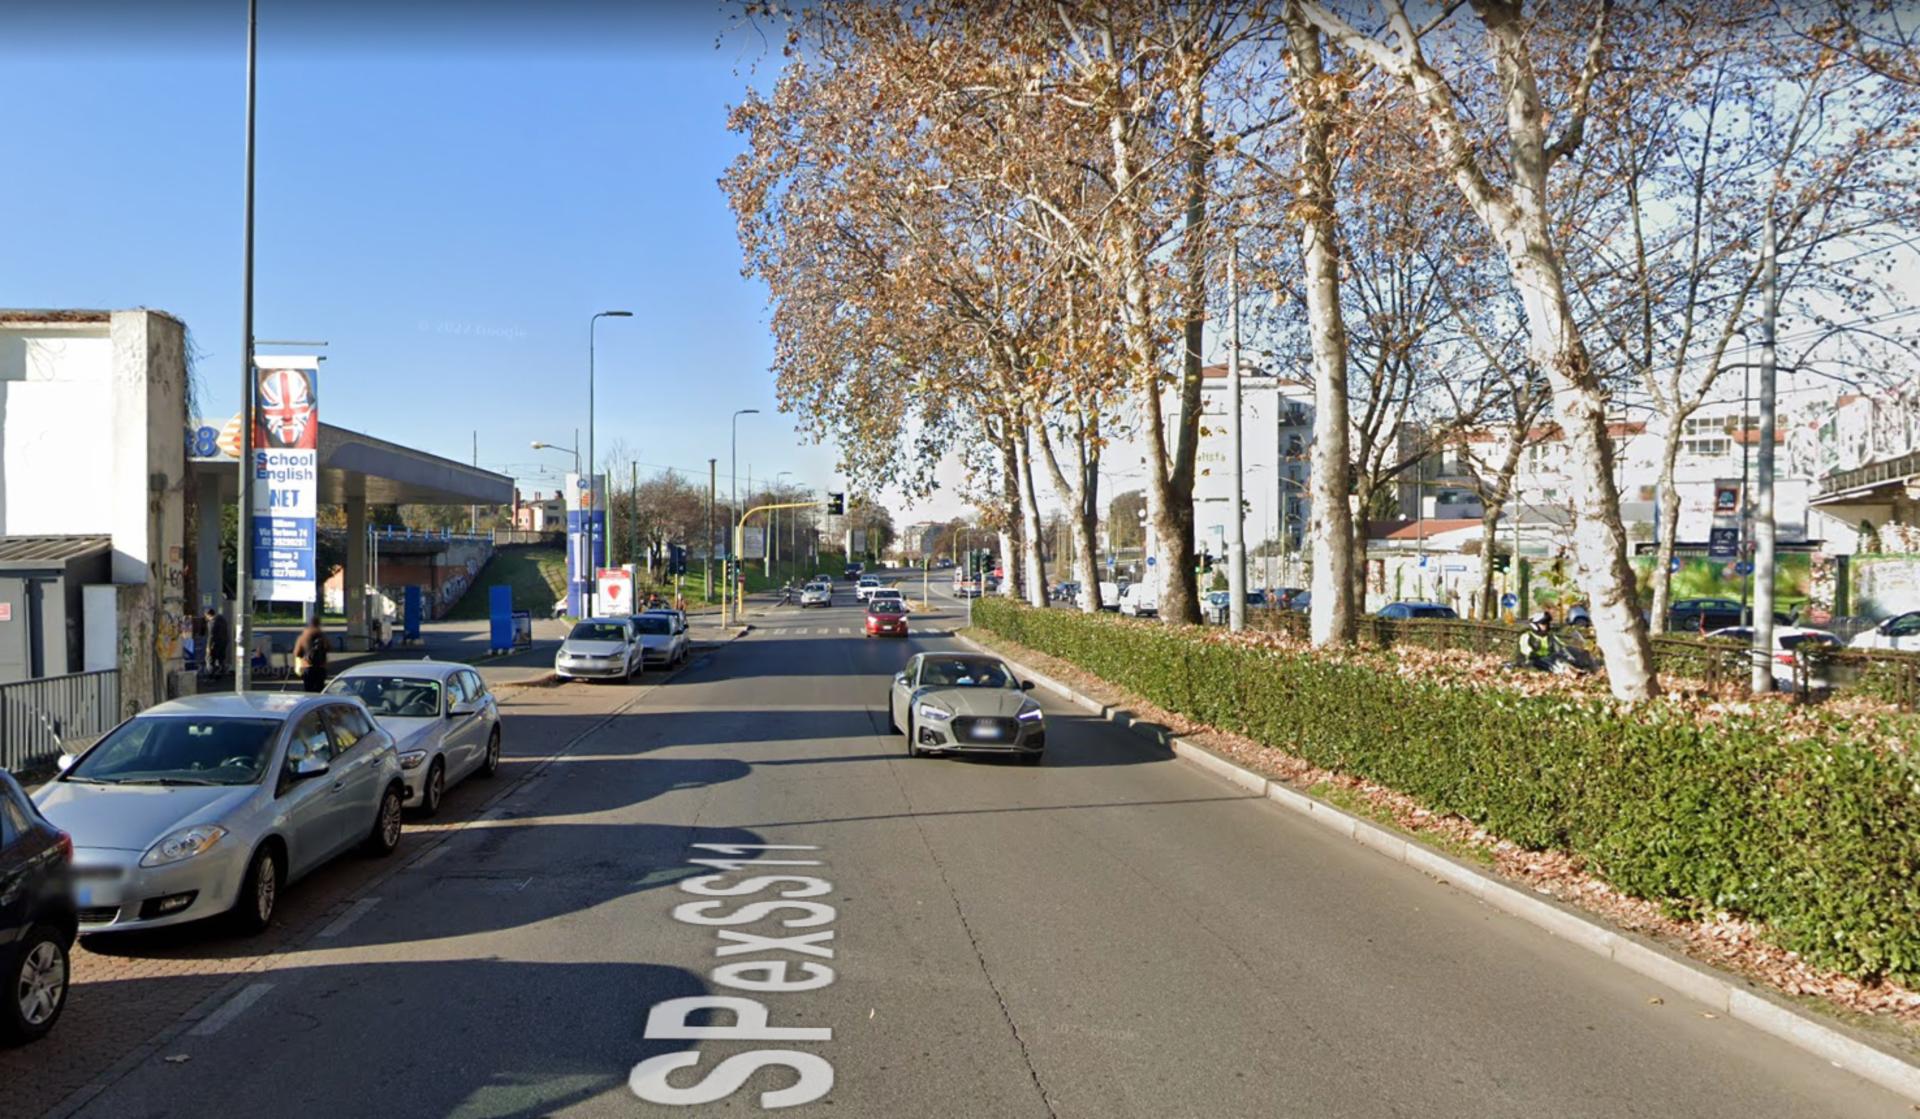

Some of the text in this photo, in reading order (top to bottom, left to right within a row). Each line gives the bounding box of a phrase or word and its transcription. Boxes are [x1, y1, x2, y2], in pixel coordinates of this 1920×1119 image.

[256, 452, 313, 466] School
[256, 468, 313, 483] English
[269, 489, 300, 507] NET
